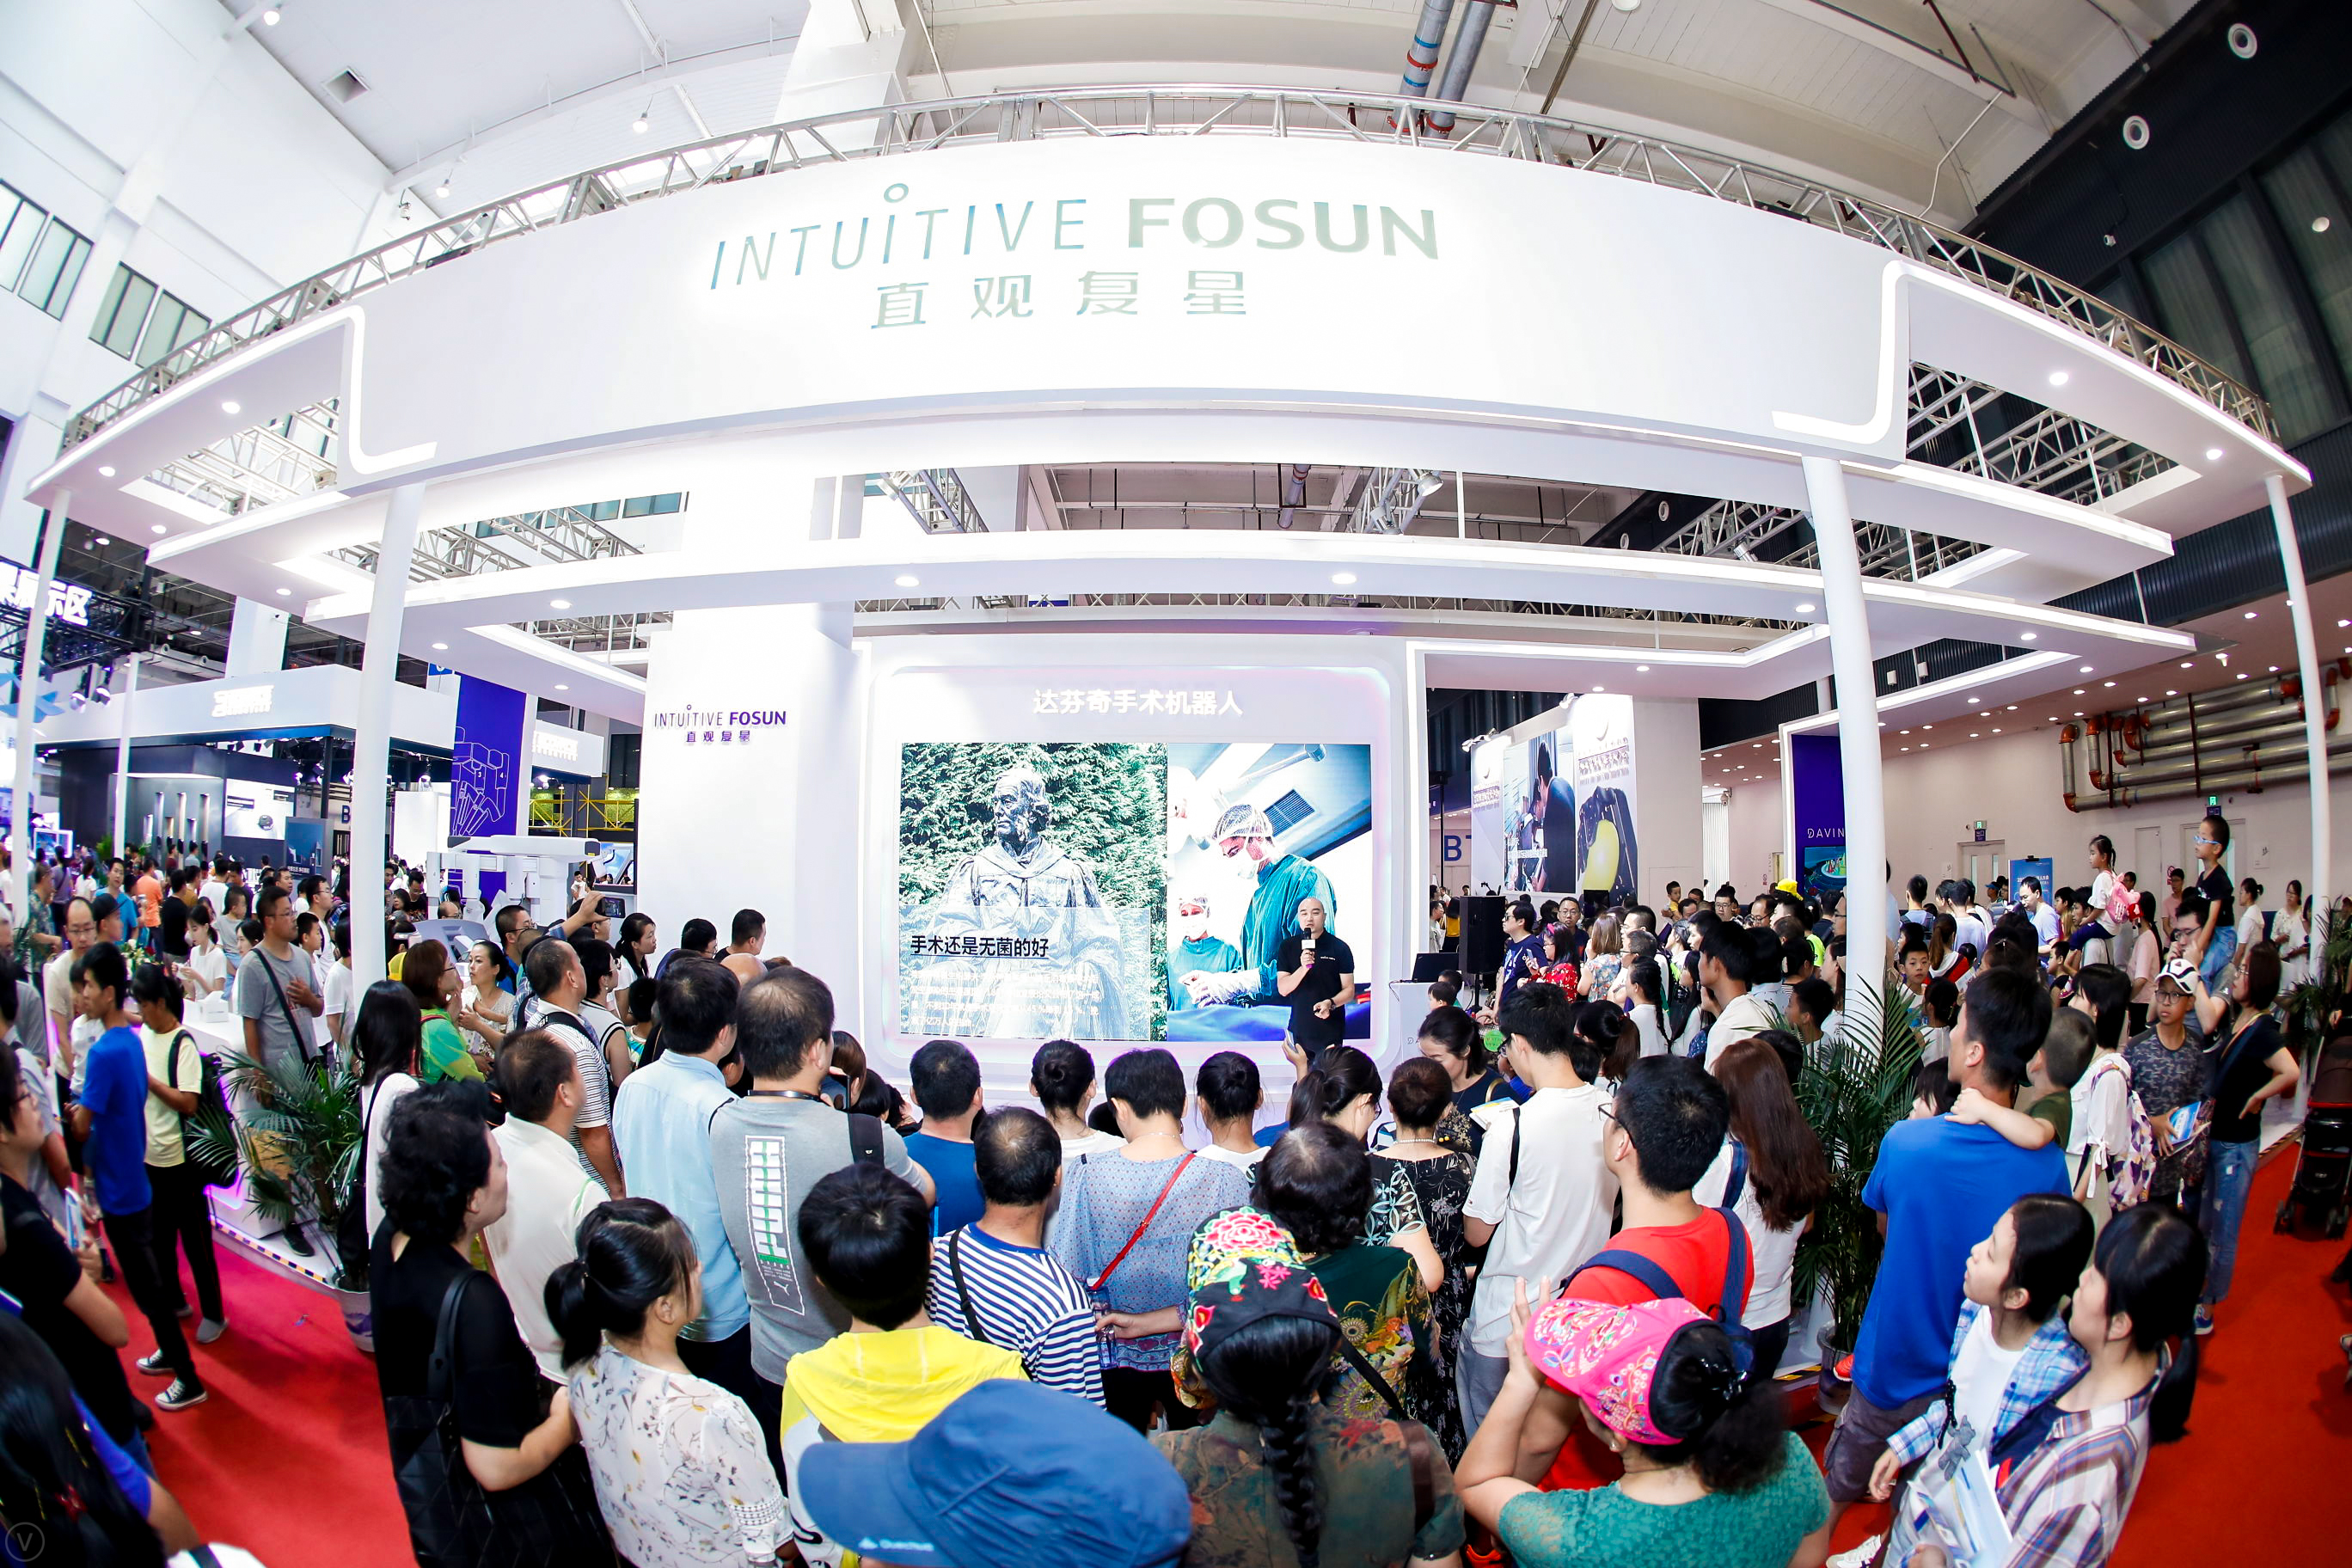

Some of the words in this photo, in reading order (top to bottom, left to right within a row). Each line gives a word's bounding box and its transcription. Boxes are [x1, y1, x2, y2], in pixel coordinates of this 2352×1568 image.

[1129, 198, 1438, 260] FOSUN
[871, 271, 1246, 329] 直观复星
[1032, 689, 1243, 715] 达芬奇手术机器人
[729, 711, 787, 726] FOSUN
[686, 731, 750, 743] 直观复星
[910, 934, 1049, 958] 手术还是无菌的好
[750, 1141, 787, 1259] PUMA
